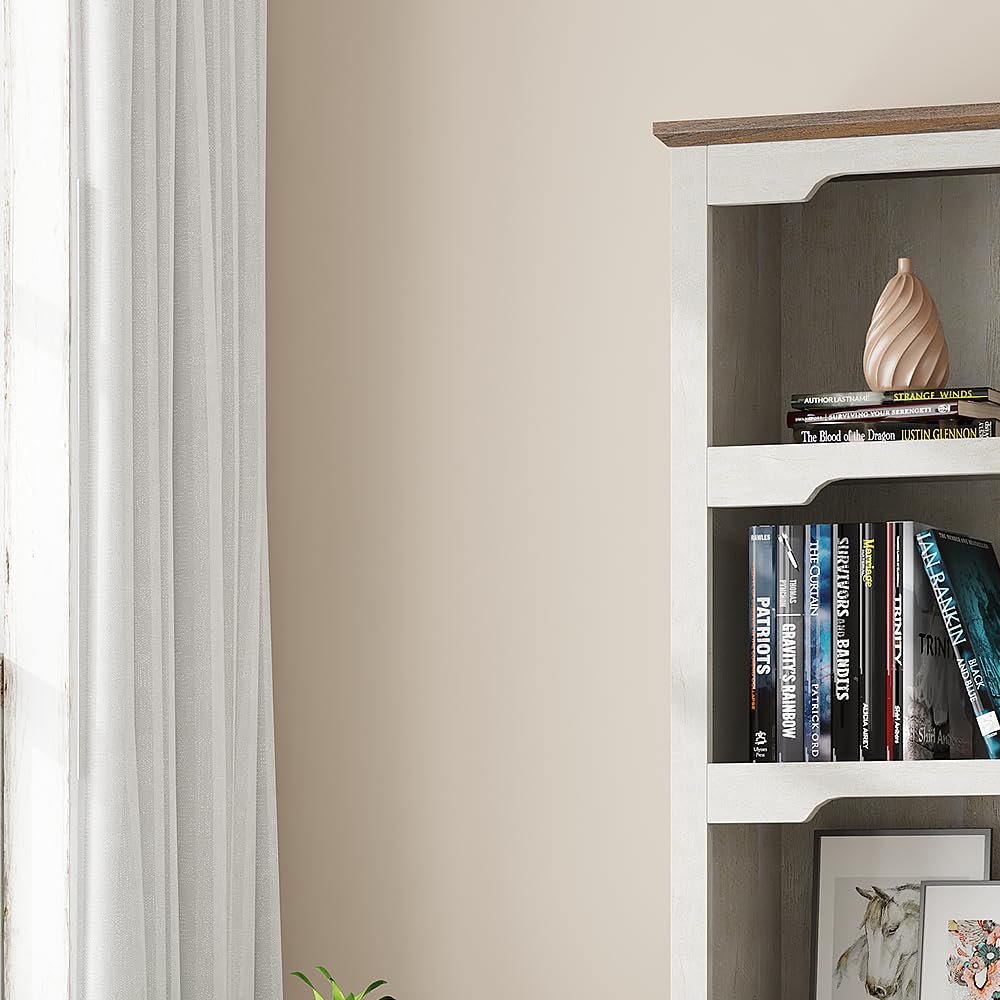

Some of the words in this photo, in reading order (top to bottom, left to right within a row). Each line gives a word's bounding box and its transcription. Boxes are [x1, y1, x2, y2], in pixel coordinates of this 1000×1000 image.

[804, 396, 834, 404] AUTHOR
[833, 395, 870, 403] LASTNAME
[893, 391, 935, 400] STRANGE
[940, 389, 973, 398] WINDS
[870, 410, 890, 418] YOUR
[801, 430, 817, 443] The
[819, 430, 842, 442] Blood
[843, 429, 852, 441] of
[853, 429, 866, 441] the
[867, 428, 896, 442] Dragon
[901, 428, 930, 441] JUSTIN
[933, 427, 977, 440] GLENNON
[809, 540, 820, 564] THE
[863, 539, 875, 588] Marriage
[789, 579, 798, 604] THOMAS
[808, 564, 821, 617] CURTAIN
[837, 537, 850, 617] SURVIVORS
[915, 531, 941, 568] IAN
[930, 573, 966, 646] RANKIN
[755, 596, 771, 675] PATRIOTS
[836, 618, 846, 638] AND
[894, 592, 902, 667] TRINITY
[781, 623, 797, 683] GRAVITY'S
[837, 638, 850, 701] BANDITS
[957, 657, 970, 681] AND
[968, 658, 985, 690] BLACK
[963, 680, 977, 703] BLUE
[781, 685, 797, 739] RAINBOW
[810, 684, 820, 730] PATRICK
[810, 732, 820, 758] ORD
